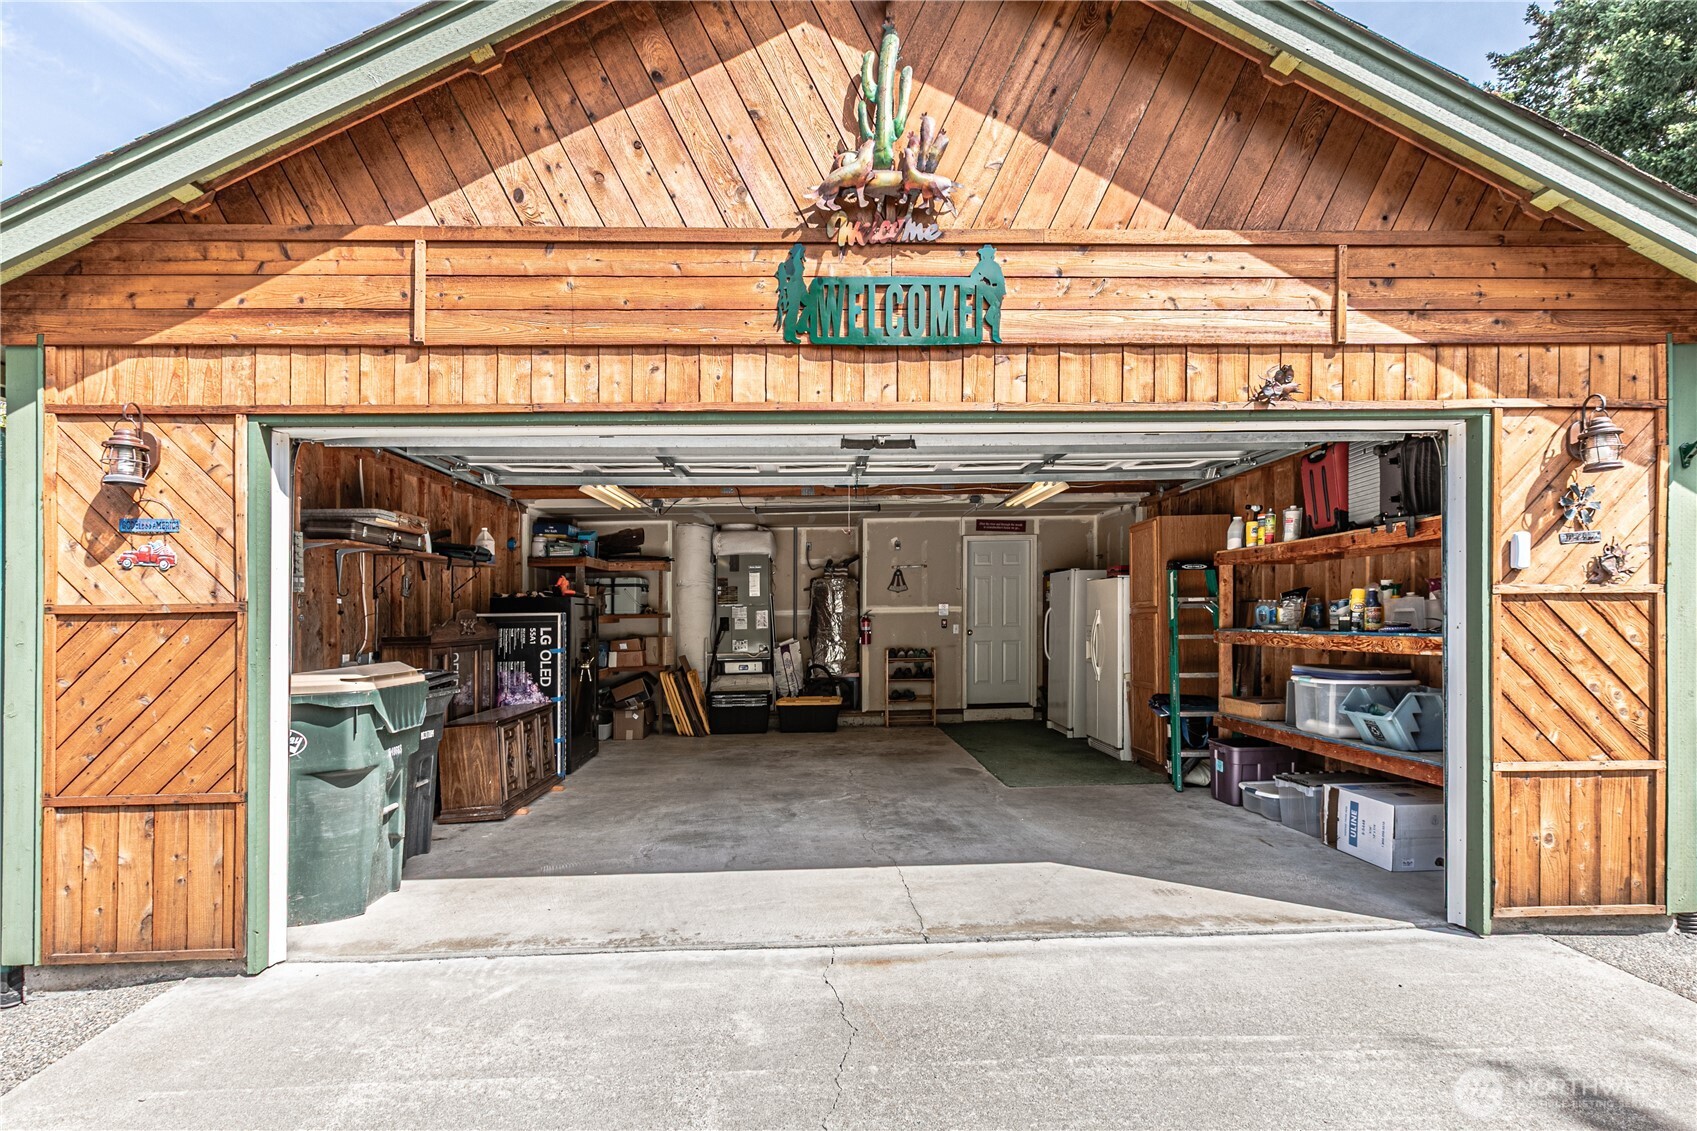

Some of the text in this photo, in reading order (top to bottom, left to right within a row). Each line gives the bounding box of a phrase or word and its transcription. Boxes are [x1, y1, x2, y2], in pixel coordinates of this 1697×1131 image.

[817, 283, 974, 338] WELCOME
[540, 627, 552, 687] LG OLED
[1350, 809, 1358, 838] ULINE
